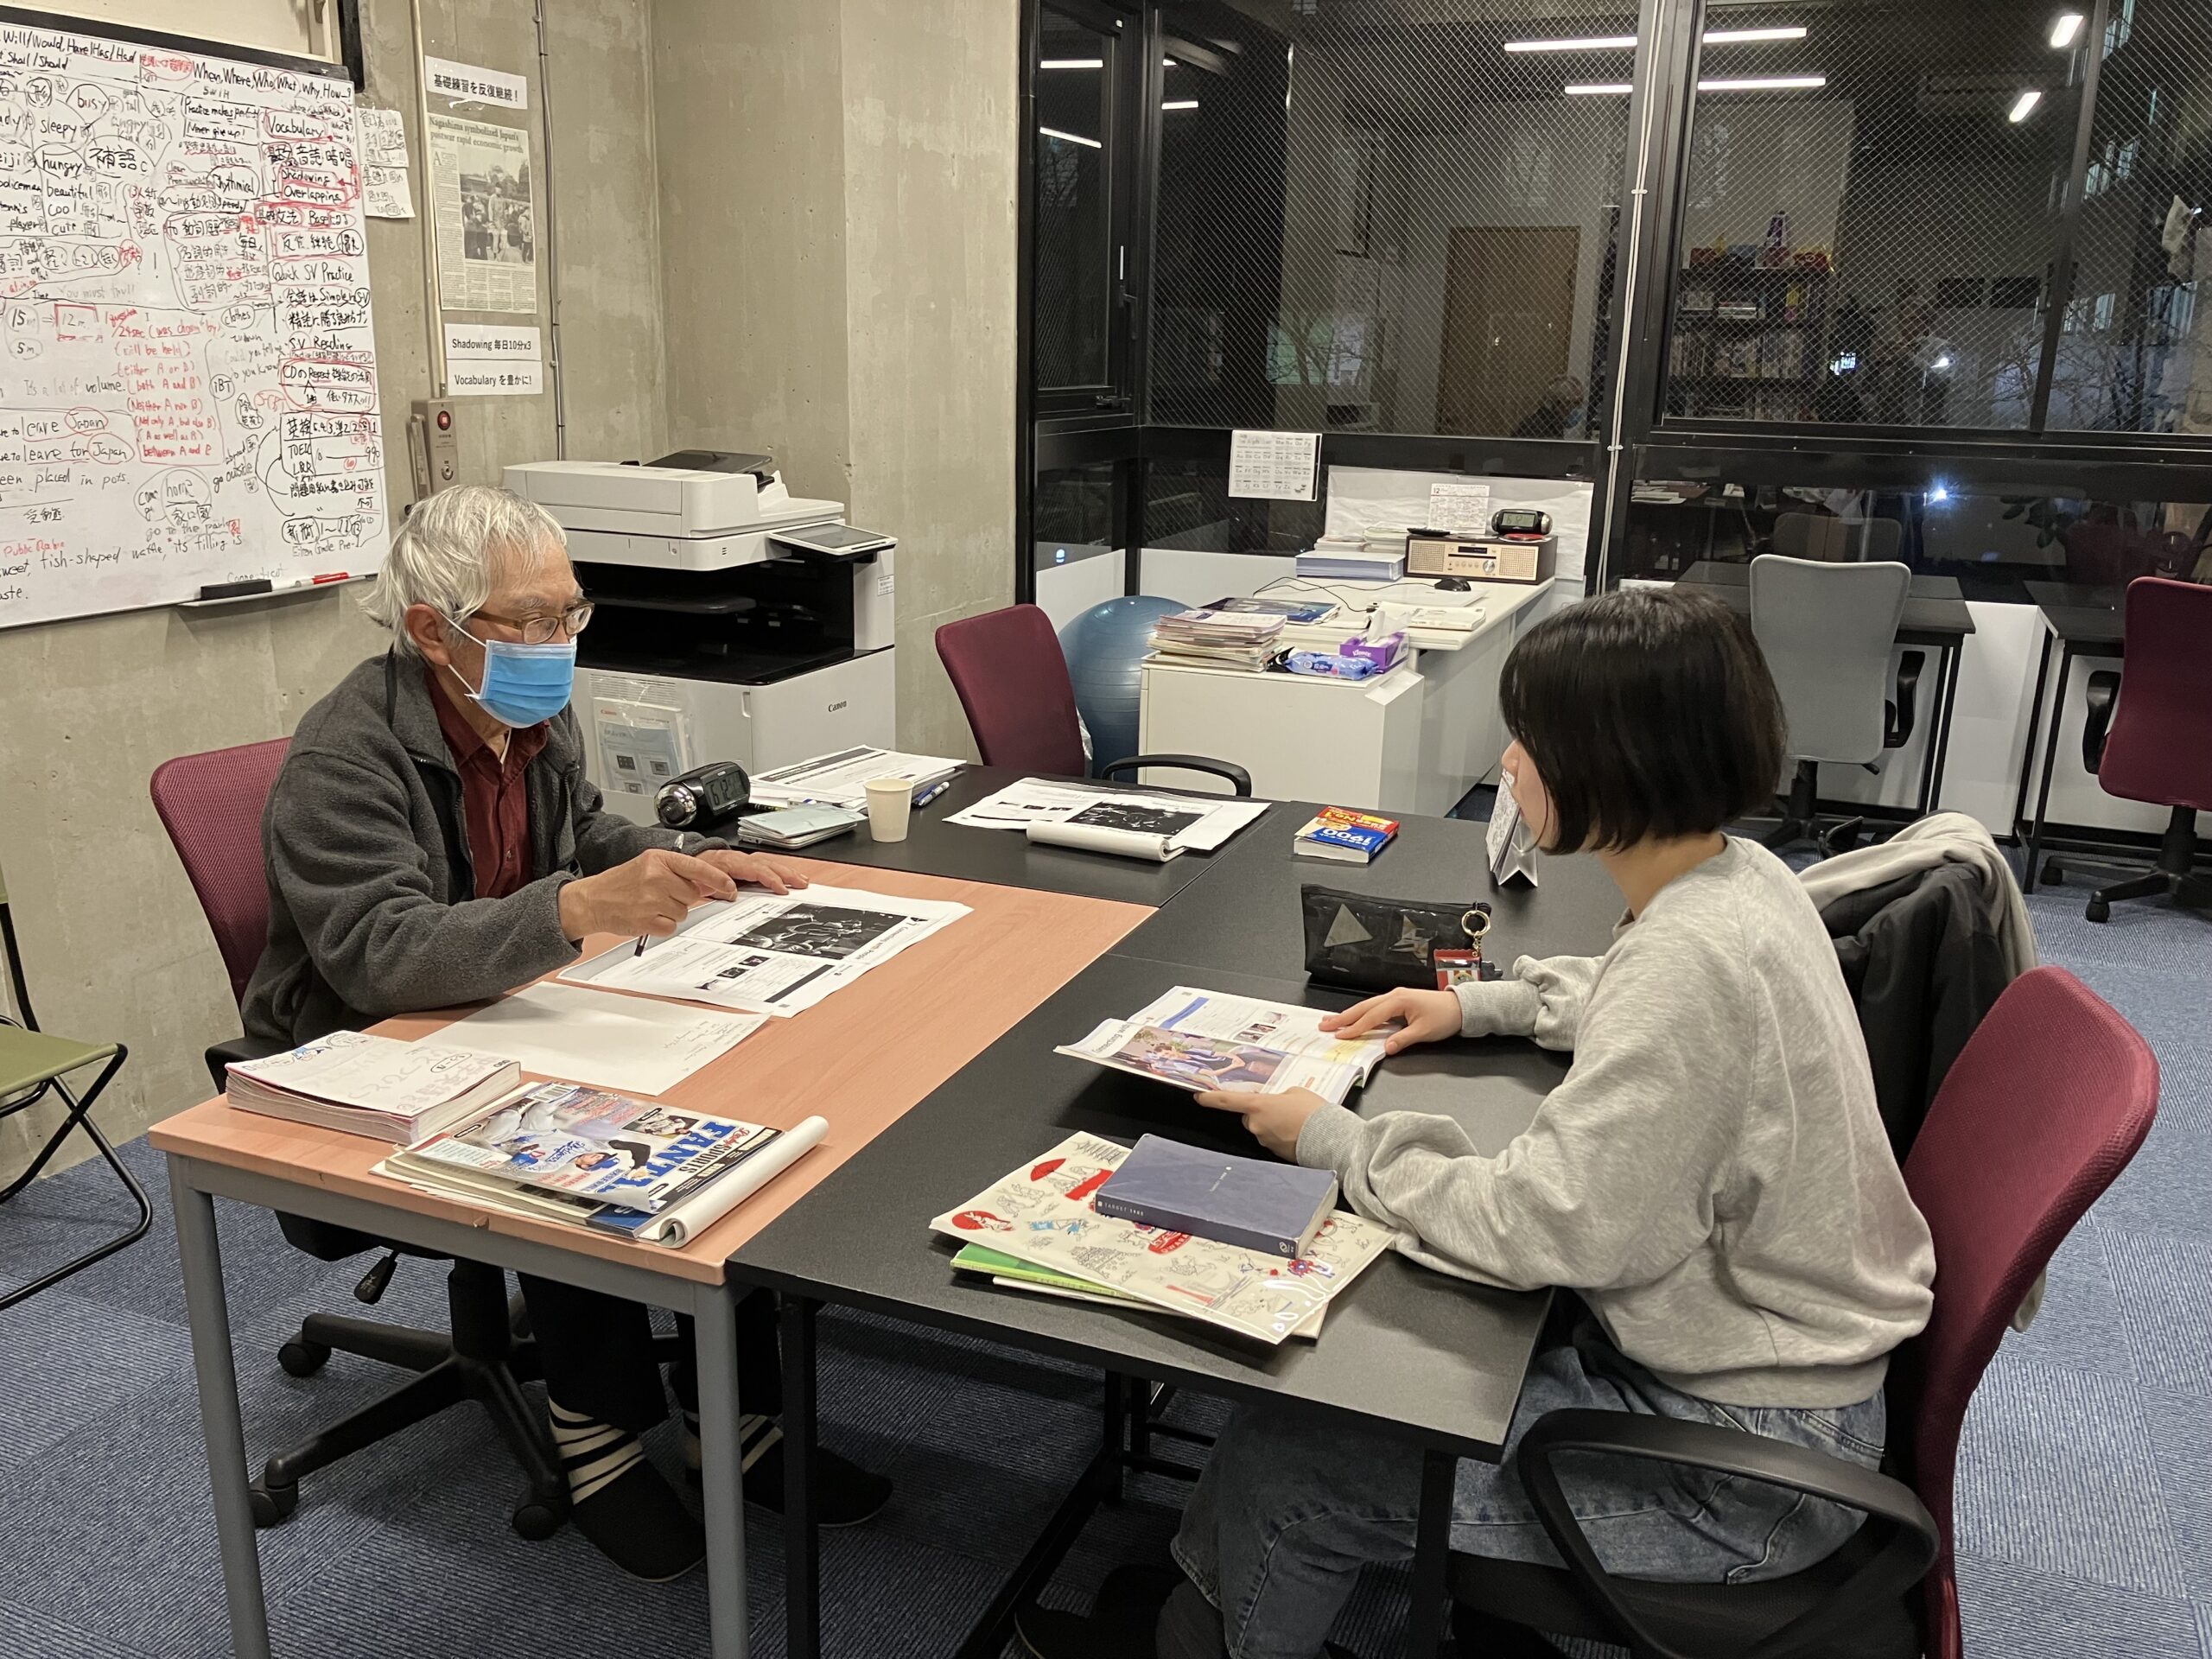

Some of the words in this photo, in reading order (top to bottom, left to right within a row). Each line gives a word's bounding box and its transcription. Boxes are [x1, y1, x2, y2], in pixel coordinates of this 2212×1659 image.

[434, 73, 518, 102] 基礎練習を反復継続！
[77, 88, 107, 113] busy
[41, 118, 78, 143] sleepy
[270, 115, 324, 138] Vocabulary
[42, 149, 84, 176] hungry
[47, 177, 93, 201] beautiful
[321, 262, 355, 283] Practice
[452, 338, 493, 351] Shadowing
[494, 339, 531, 351] 毎日10分x3
[86, 375, 126, 393] volume.
[454, 375, 497, 388] Vocabulary
[499, 374, 532, 386] を豊かに!
[68, 412, 105, 430] Japan
[24, 444, 62, 463] leave
[92, 442, 127, 461] Japan
[35, 467, 71, 493] placed
[80, 475, 93, 486] in
[40, 546, 123, 570] fish-shaped
[828, 700, 847, 713] Canon
[1323, 829, 1372, 844] 1900
[545, 1140, 586, 1163] Dodgers
[678, 1143, 731, 1173] SPORTS
[1104, 1201, 1128, 1212] TARGET
